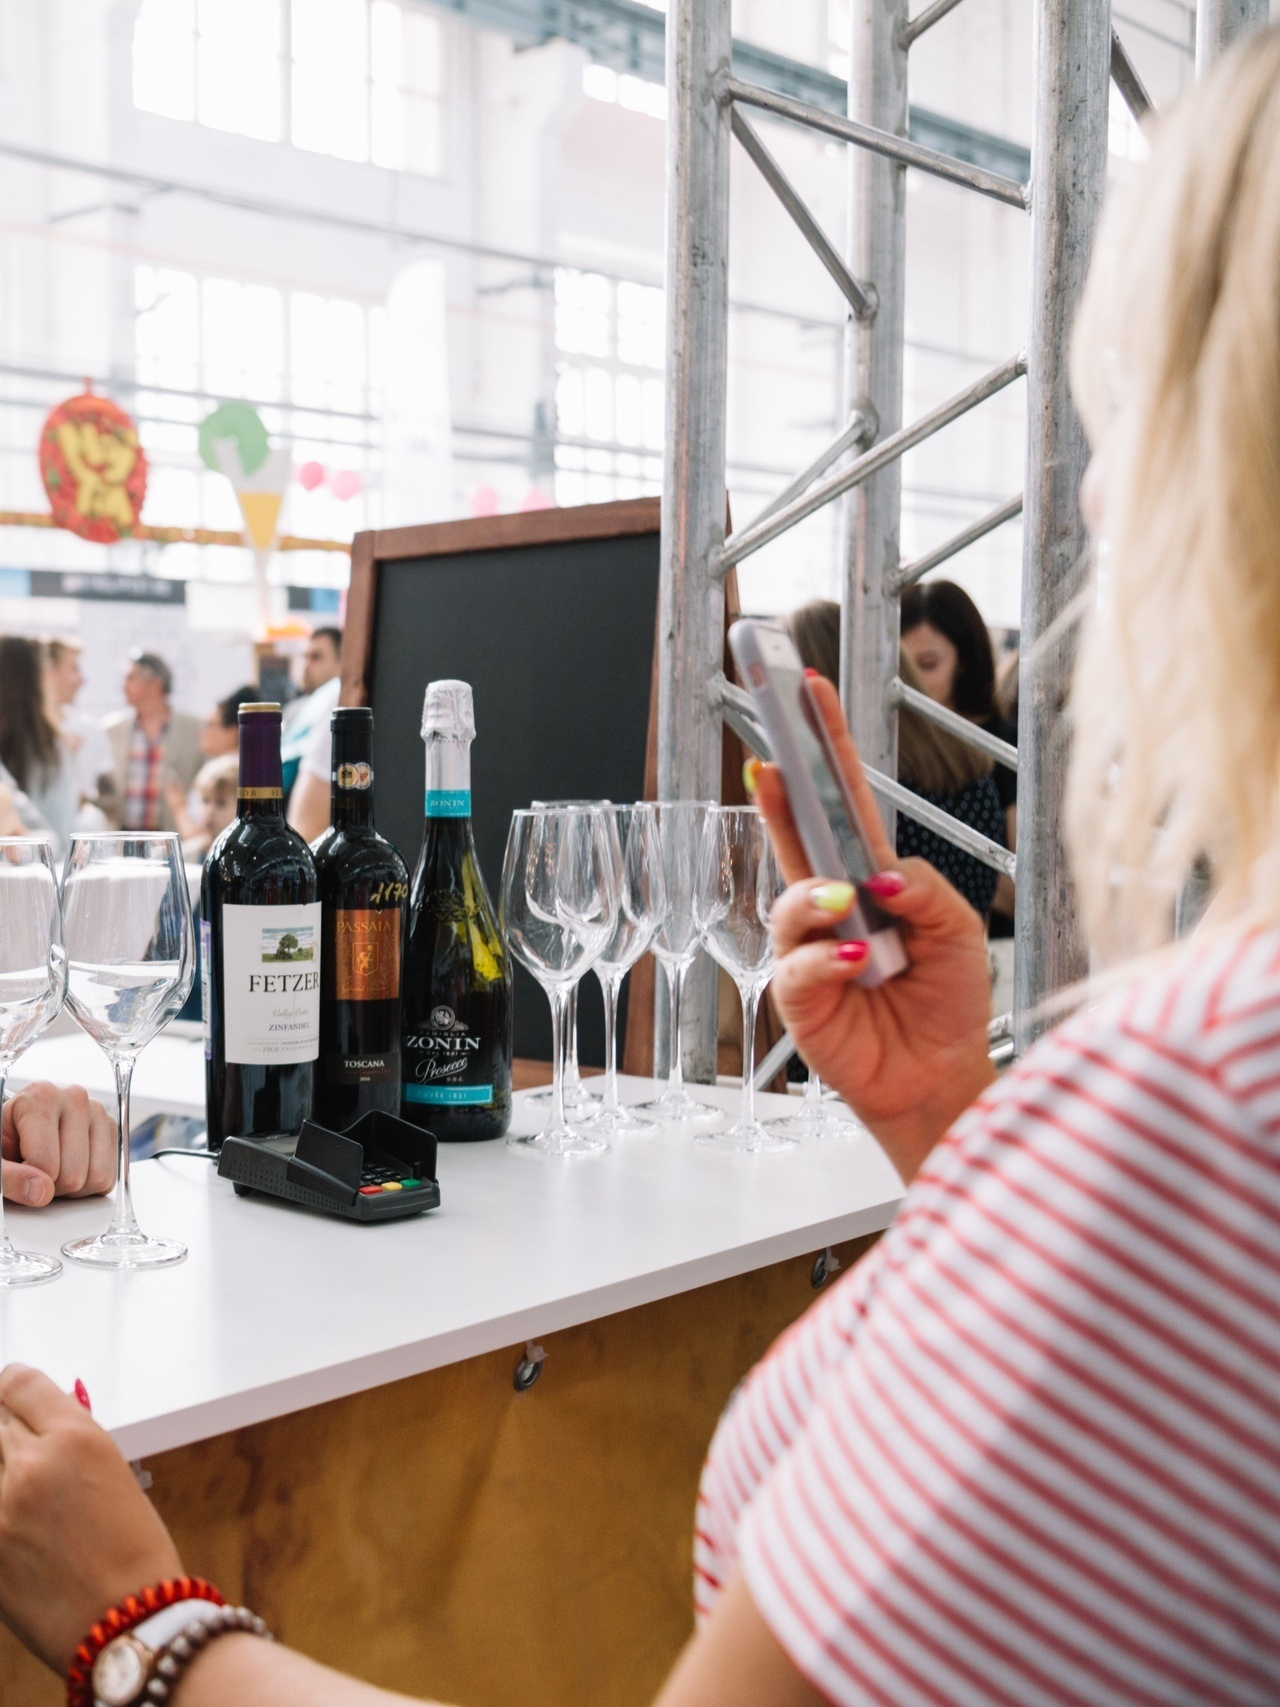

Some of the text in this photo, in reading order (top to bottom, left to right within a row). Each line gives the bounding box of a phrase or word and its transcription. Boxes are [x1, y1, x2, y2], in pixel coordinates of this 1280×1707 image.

[430, 799, 465, 807] ZONIN
[337, 920, 392, 933] PASSAIA
[248, 971, 320, 993] FETZER
[268, 1022, 311, 1032] ZINFANDEL
[406, 1034, 482, 1051] ZONIN
[343, 1059, 385, 1068] TOSCANA
[415, 1055, 469, 1085] Prosecco
